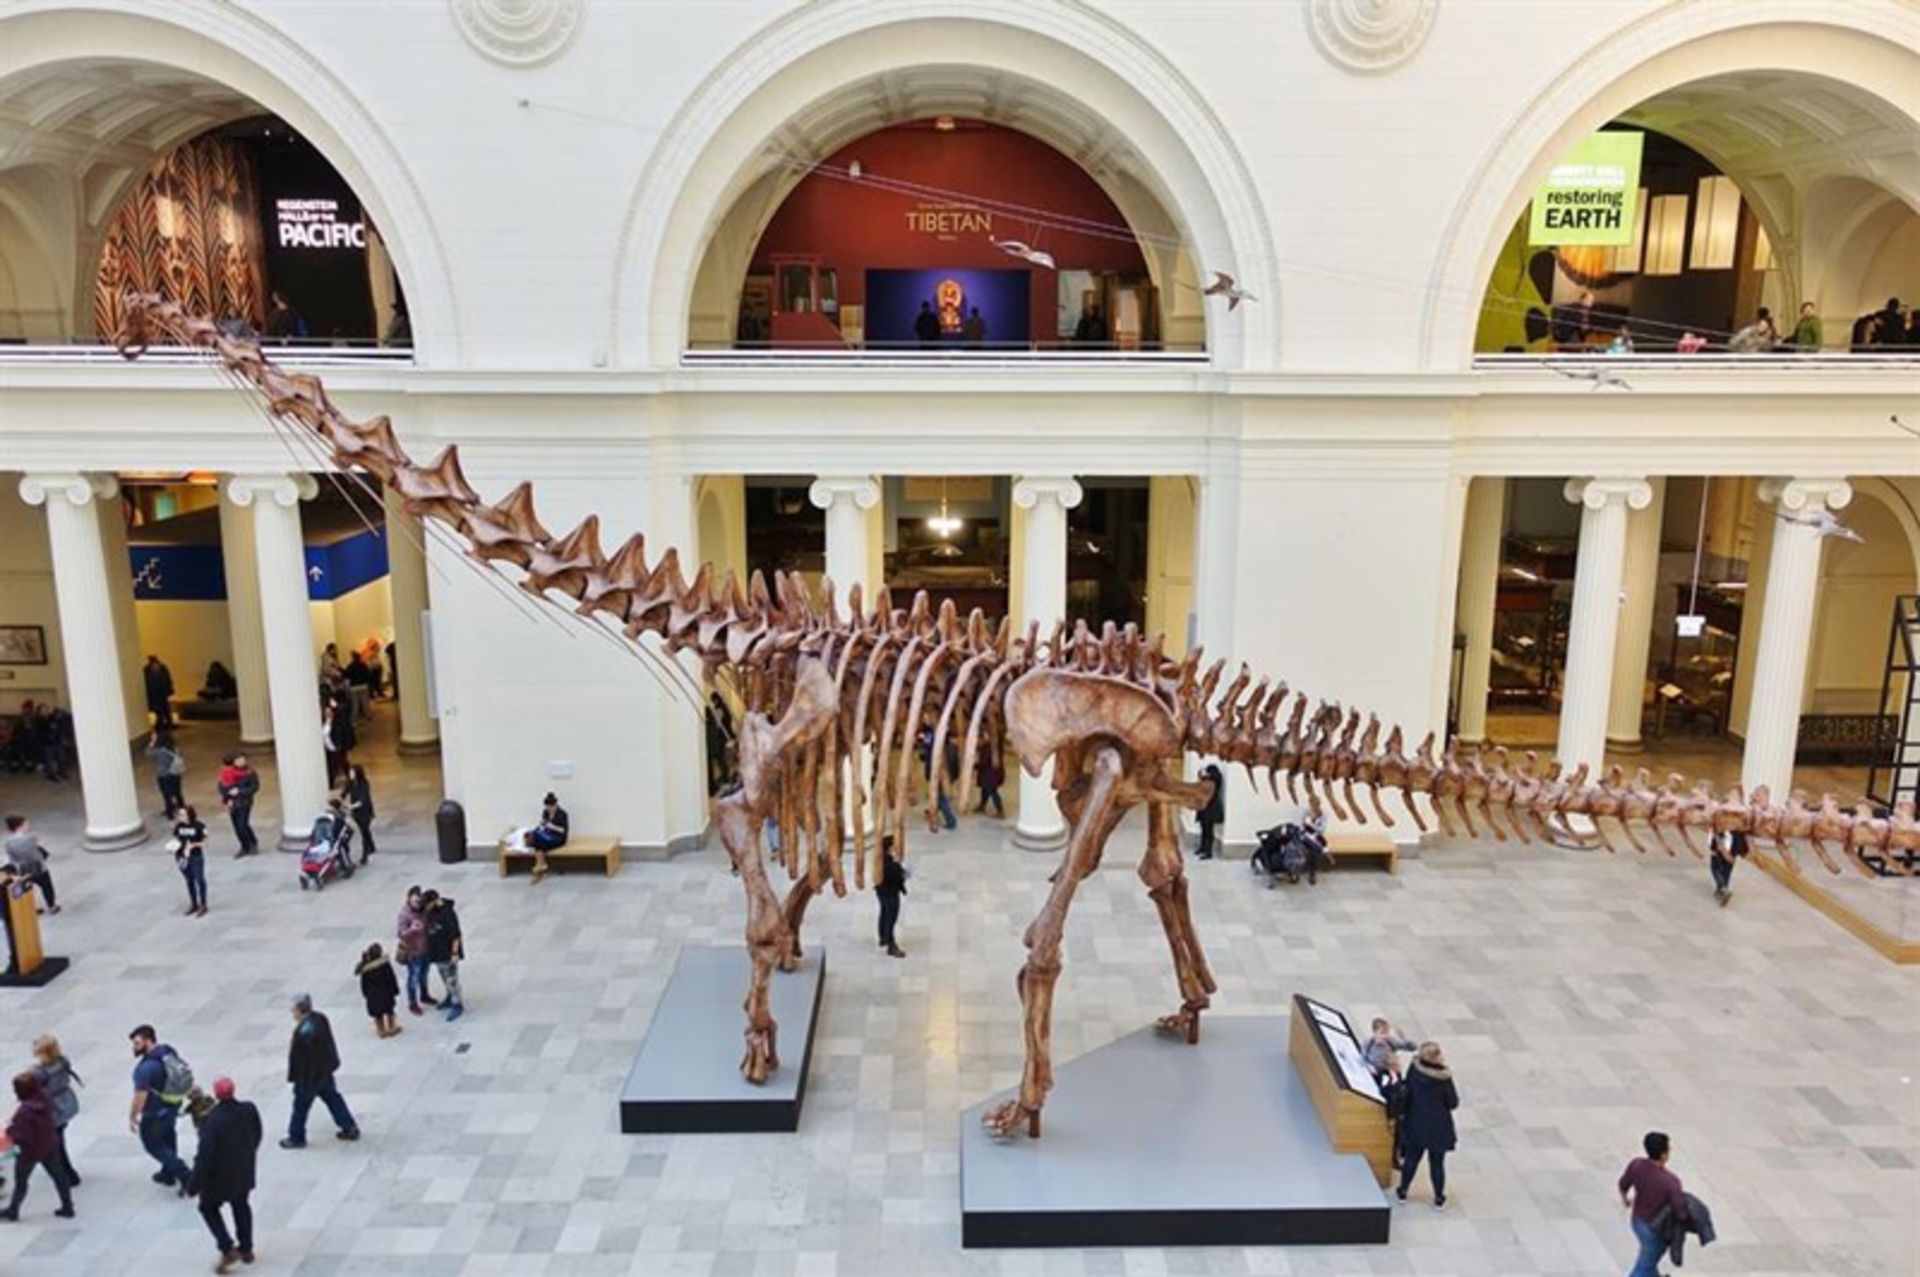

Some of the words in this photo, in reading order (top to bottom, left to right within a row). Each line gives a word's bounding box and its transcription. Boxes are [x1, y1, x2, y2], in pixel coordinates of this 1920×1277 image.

[1547, 189, 1623, 207] restoring
[904, 212, 992, 231] TIBETAN
[1545, 208, 1621, 228] EARTH
[279, 222, 365, 248] PACIFIC
